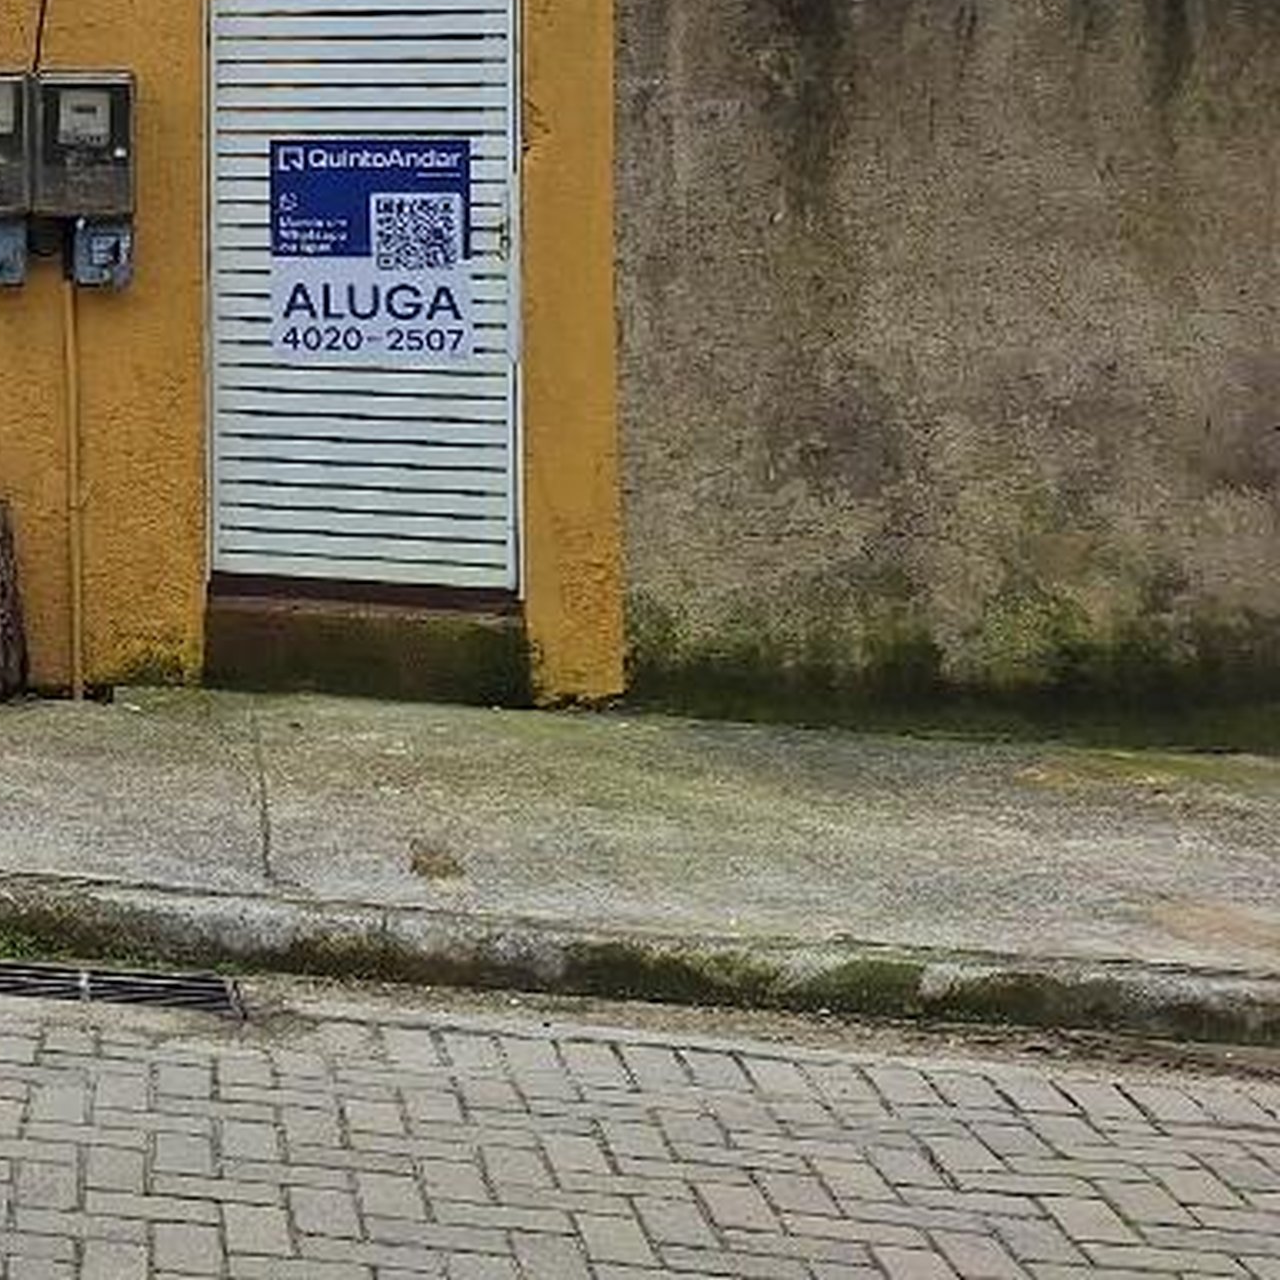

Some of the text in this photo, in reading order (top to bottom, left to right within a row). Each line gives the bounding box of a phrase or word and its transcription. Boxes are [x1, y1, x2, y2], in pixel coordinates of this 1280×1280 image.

[308, 148, 462, 168] QuintoAndar
[283, 283, 463, 320] ALUGA
[282, 326, 465, 351] 4020-2507
